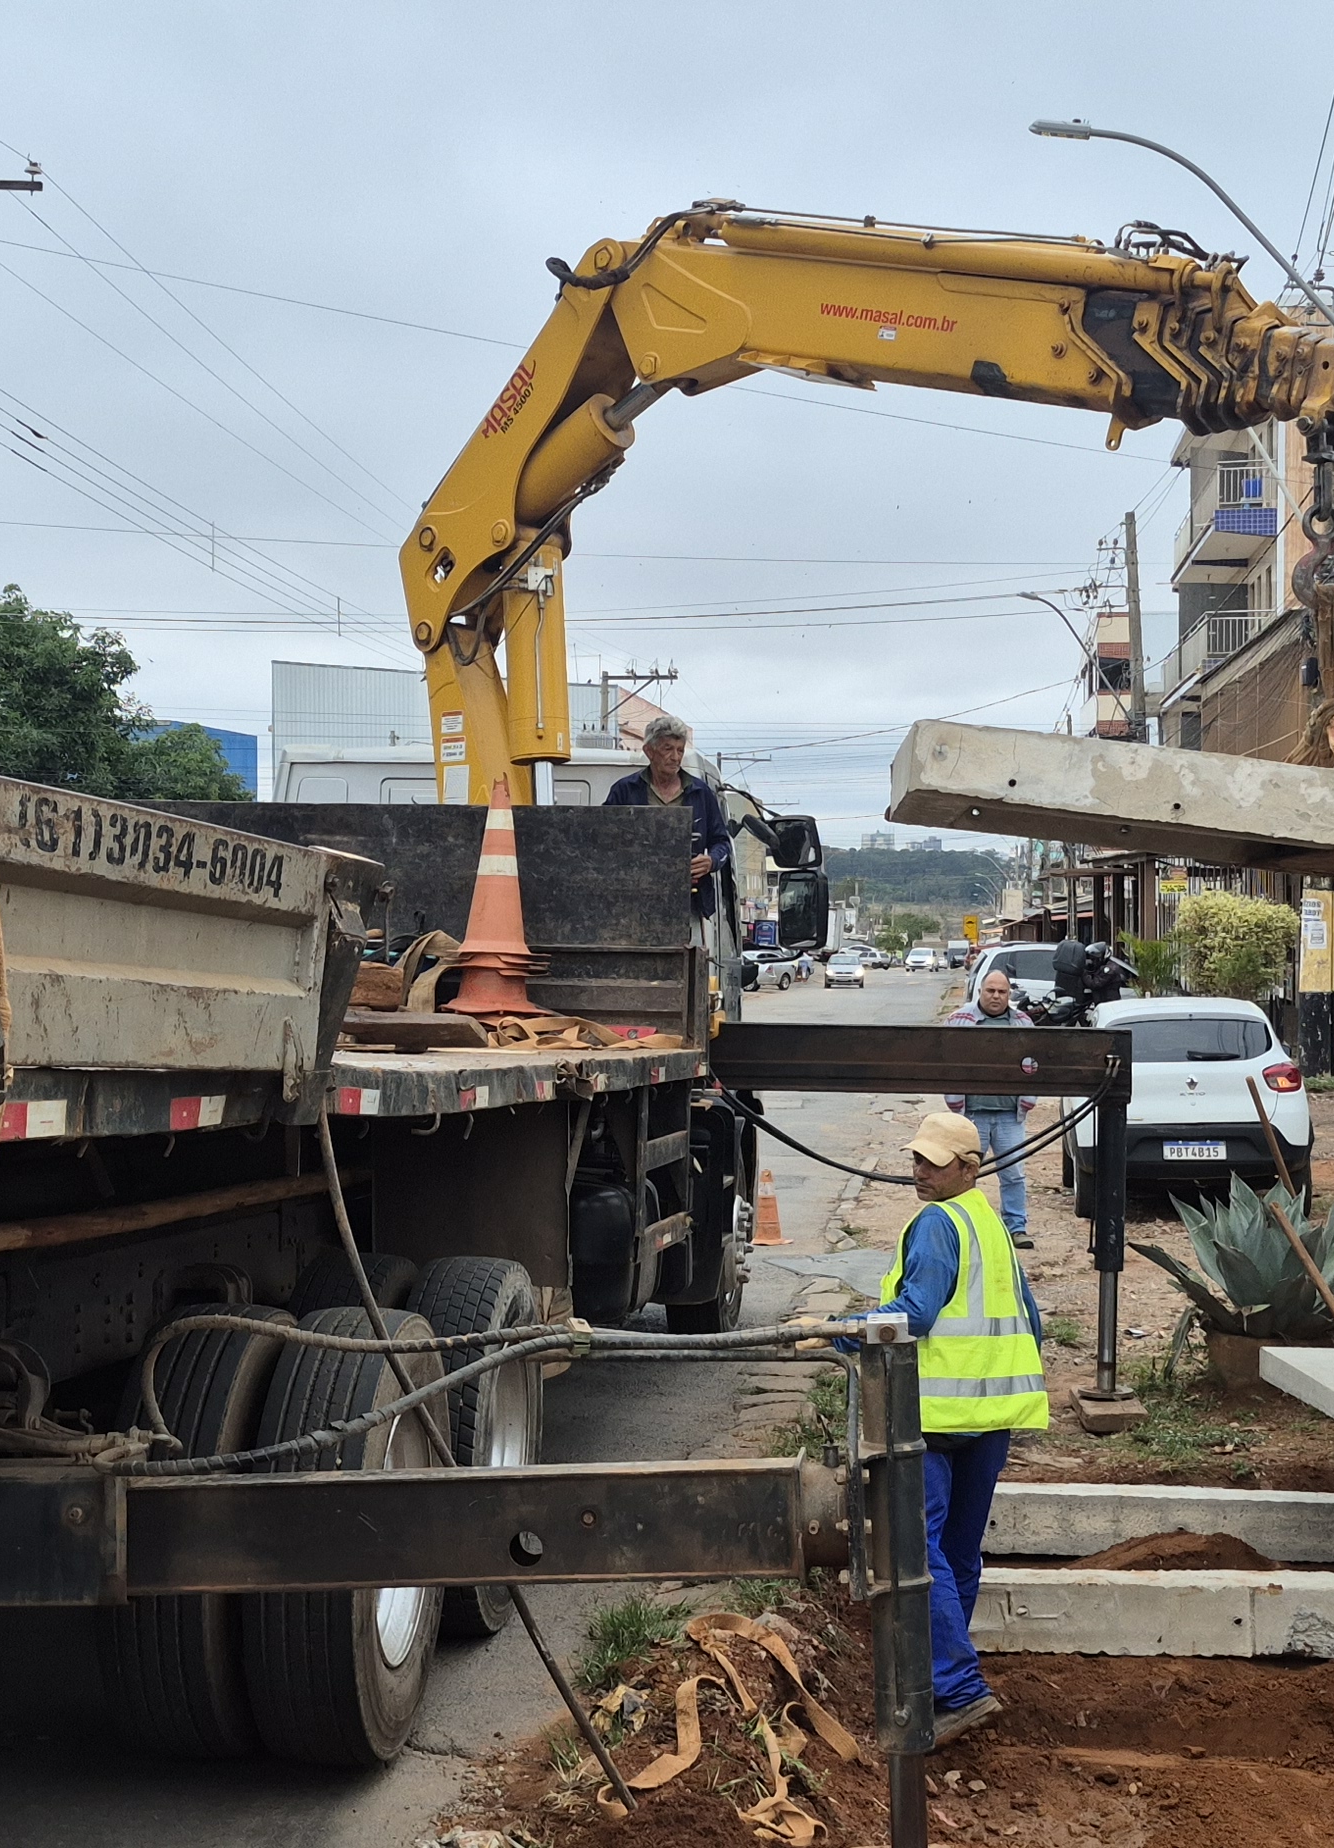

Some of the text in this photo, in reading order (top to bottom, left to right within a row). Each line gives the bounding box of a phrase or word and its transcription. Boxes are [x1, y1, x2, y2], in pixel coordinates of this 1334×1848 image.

[820, 302, 958, 333] www.masal.com.br
[481, 359, 537, 439] MASAL
[500, 382, 534, 434] MS 45007
[1169, 1147, 1219, 1158] PBT4B15
